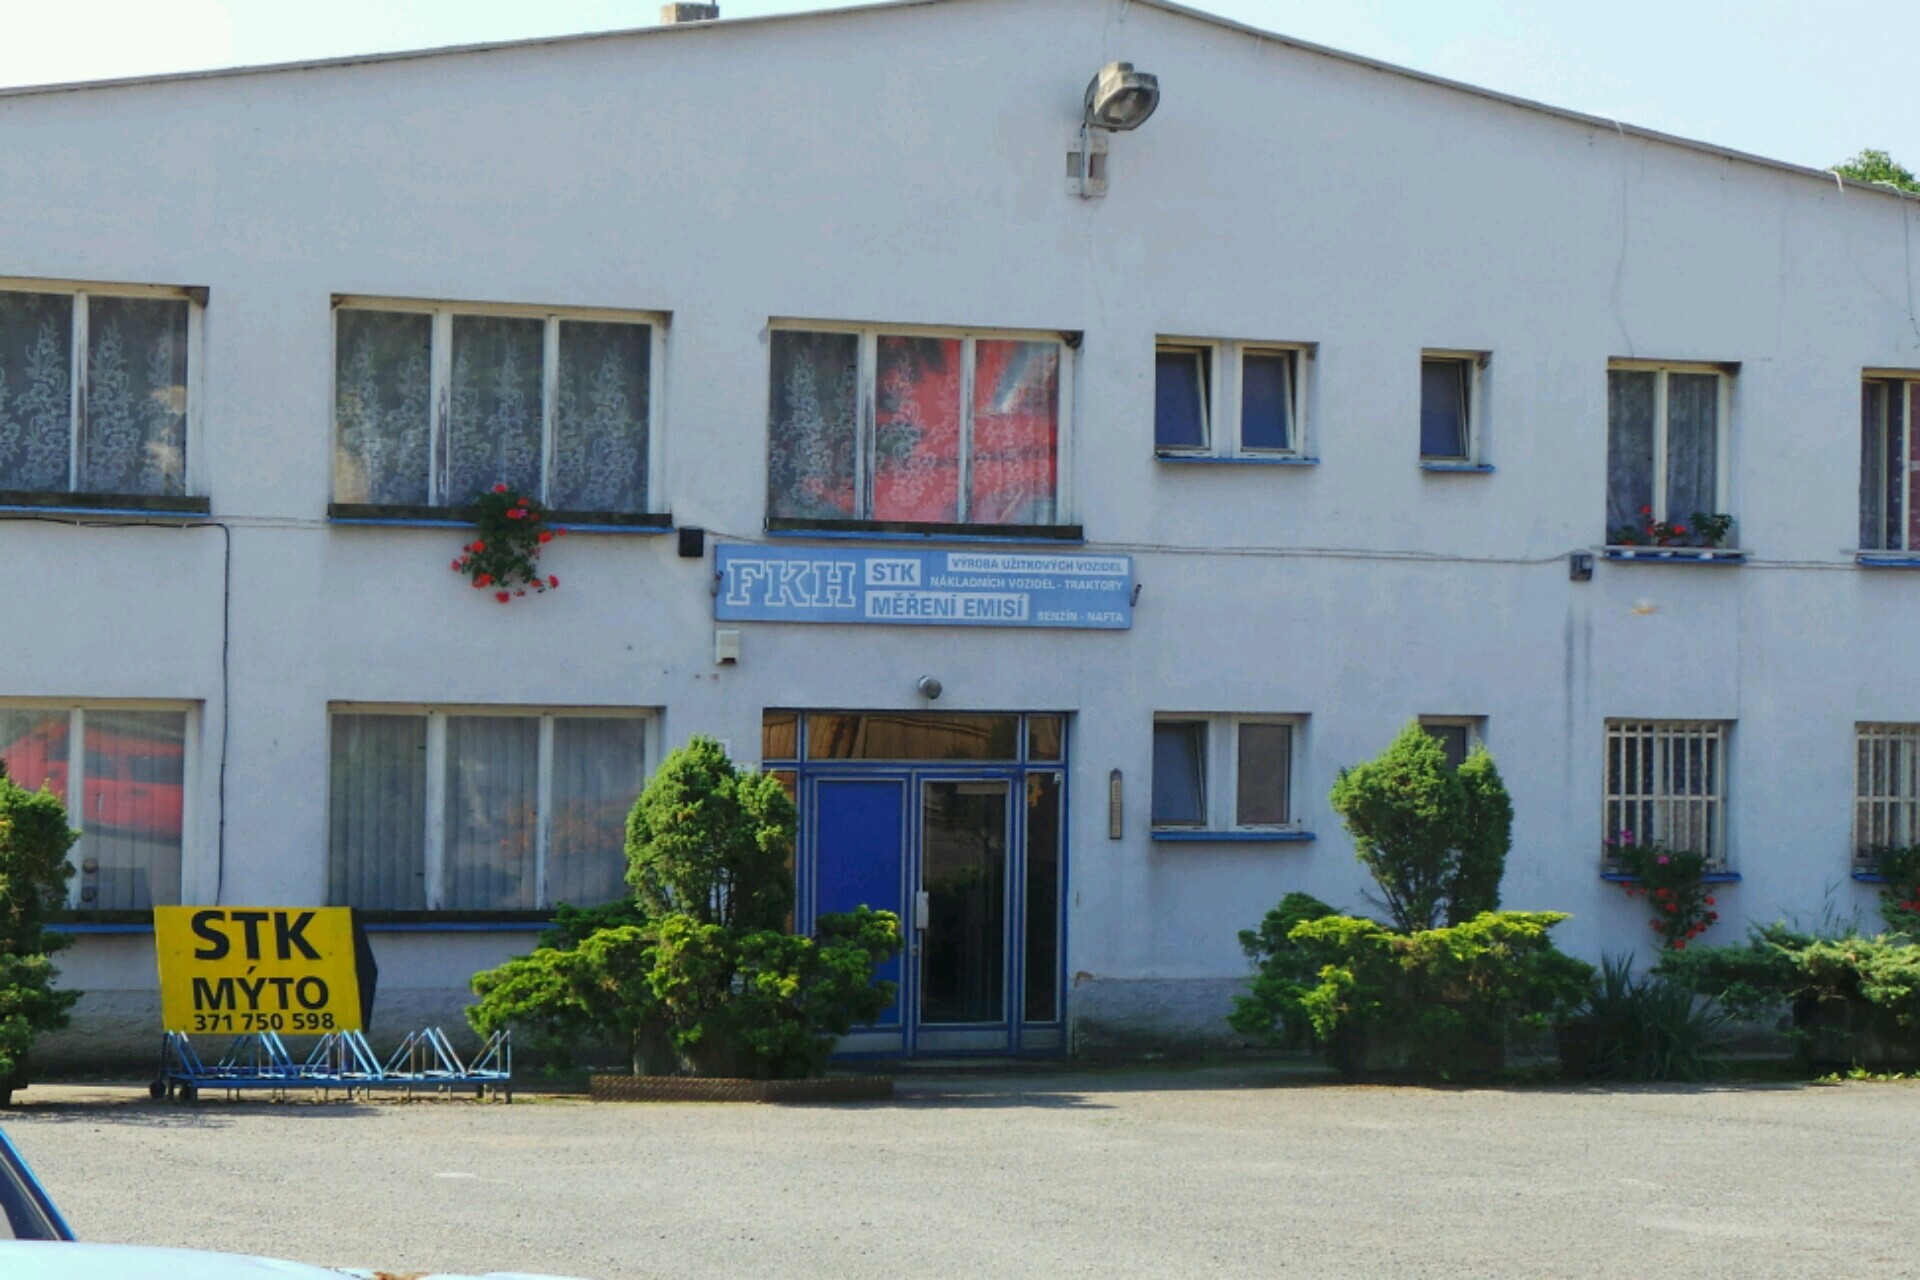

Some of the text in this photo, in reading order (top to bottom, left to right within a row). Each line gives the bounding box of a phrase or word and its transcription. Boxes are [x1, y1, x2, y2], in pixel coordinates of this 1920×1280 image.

[872, 563, 915, 582] STK
[1077, 561, 1122, 572] VOZIDEL
[727, 559, 856, 608] FKH
[1009, 578, 1055, 590] VOZIDEL
[1065, 580, 1123, 591] TRAKTORY
[872, 592, 1023, 617] MĚŘENÍ EMISÍ
[1087, 612, 1124, 622] NAFTA
[191, 910, 322, 960] STK
[192, 966, 329, 1010] MÝTO
[194, 1013, 335, 1031] 371 750 598
